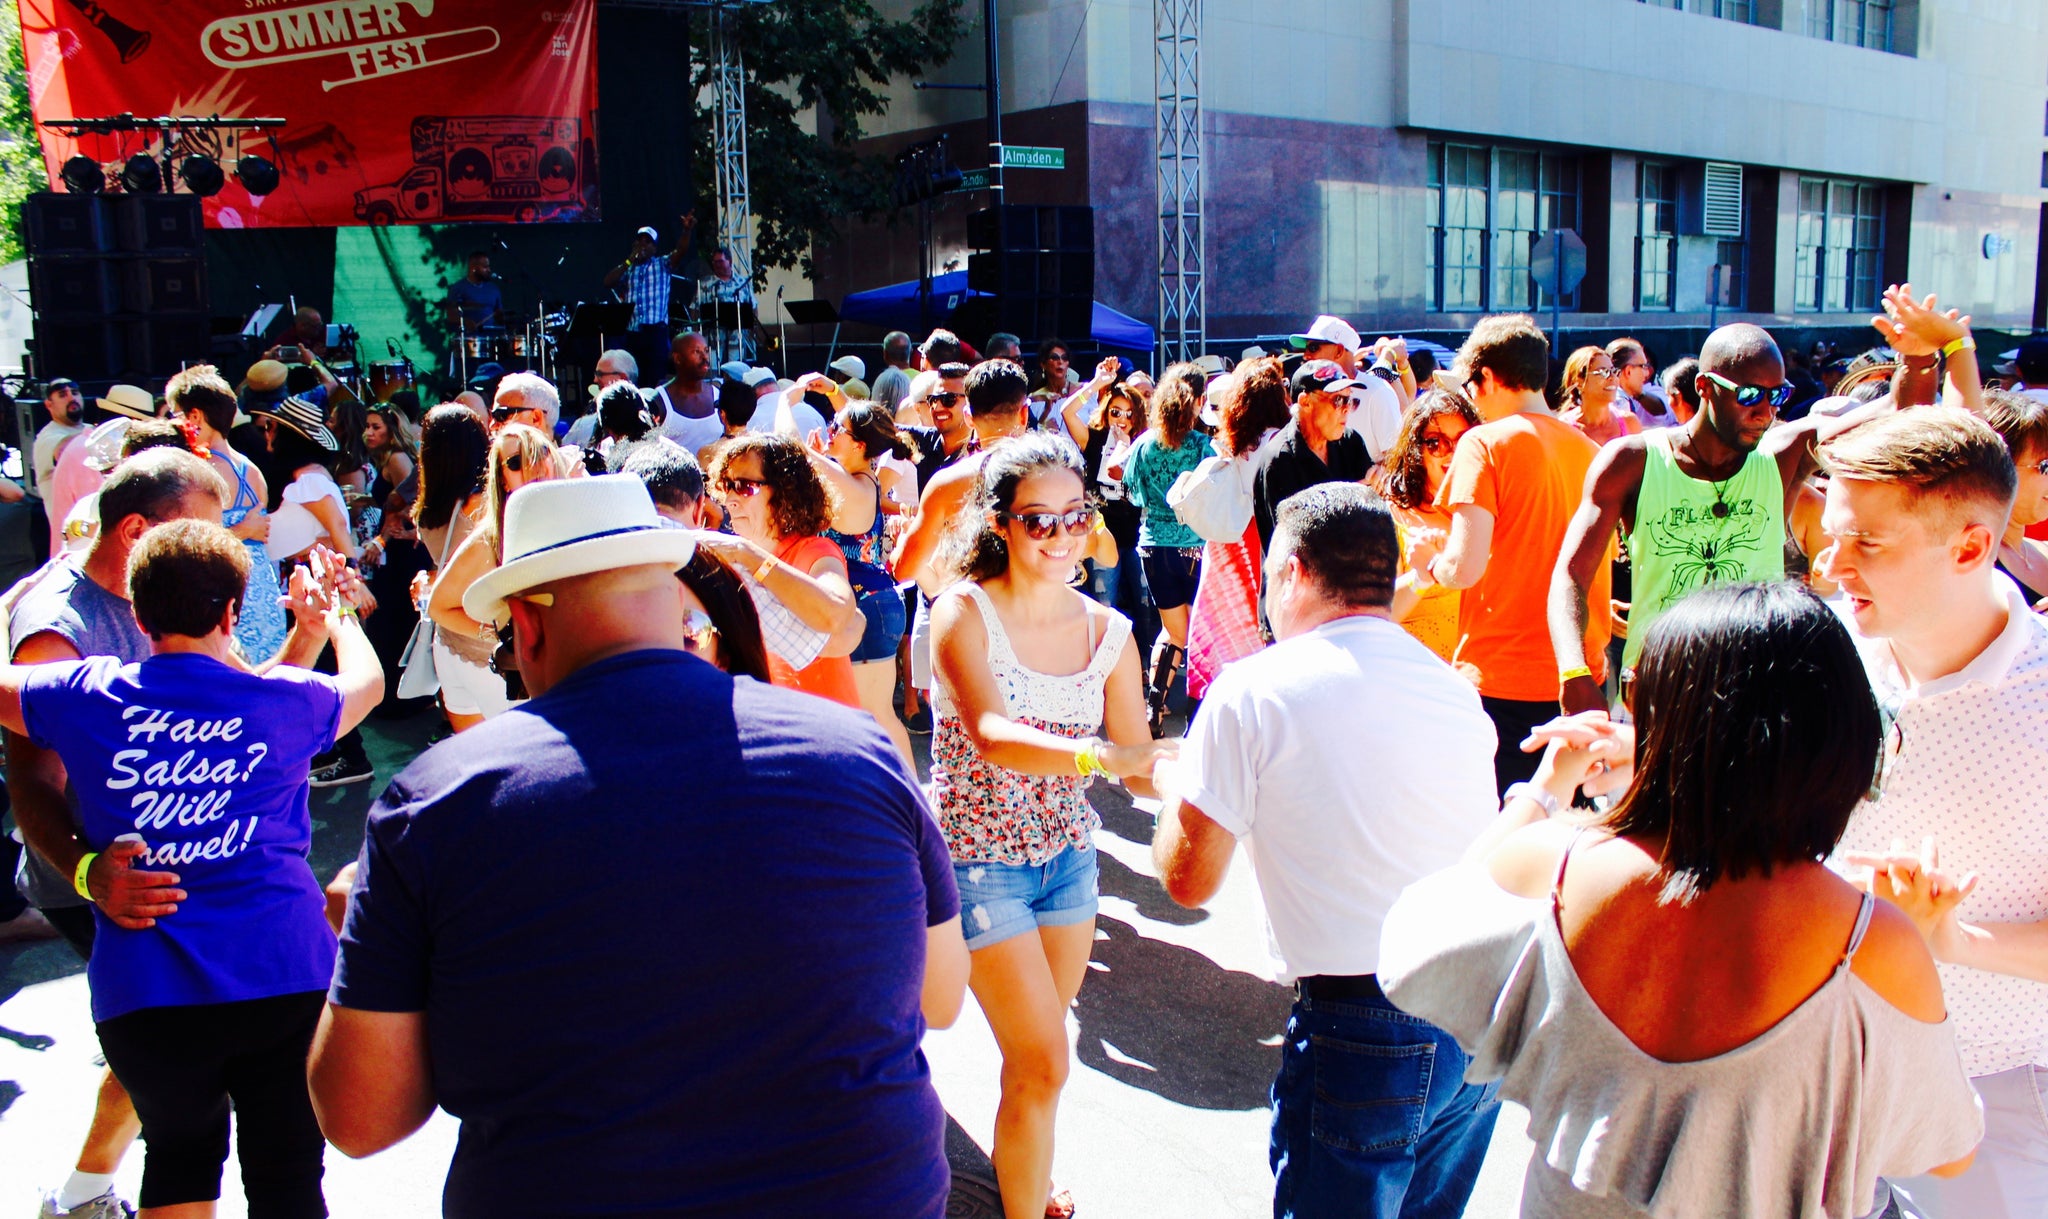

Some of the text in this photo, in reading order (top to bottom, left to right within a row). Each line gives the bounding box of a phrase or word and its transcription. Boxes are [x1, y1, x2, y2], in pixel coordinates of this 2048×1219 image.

[220, 2, 407, 57] SUMMER
[348, 38, 427, 80] FEST
[1005, 150, 1051, 164] Almaden
[1670, 499, 1753, 526] FLAAZ
[122, 705, 243, 743] Have
[106, 742, 268, 789] Salsa?
[131, 789, 232, 830] Will
